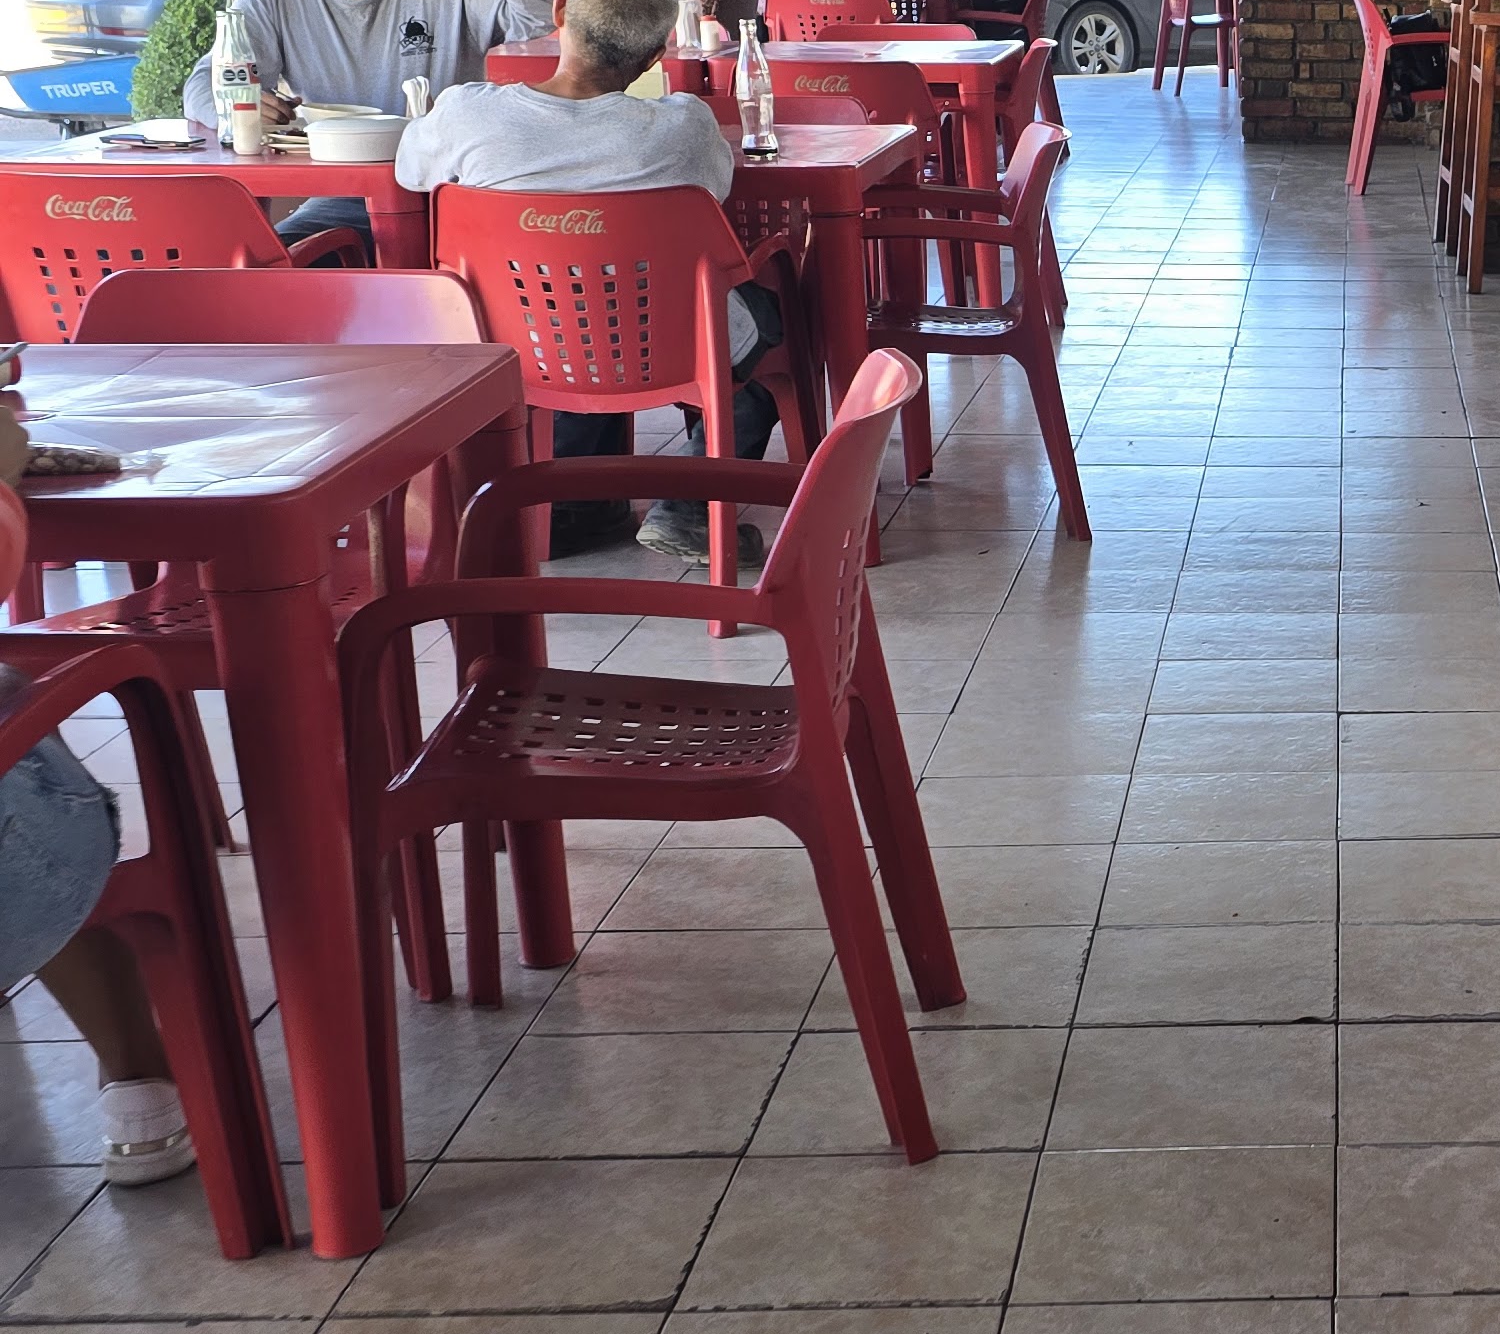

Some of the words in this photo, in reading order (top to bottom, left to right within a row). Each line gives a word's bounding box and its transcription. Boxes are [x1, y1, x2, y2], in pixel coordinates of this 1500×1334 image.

[41, 81, 118, 99] TRUPER
[45, 194, 136, 222] Coca-Cola
[519, 208, 606, 234] Coca-Cola
